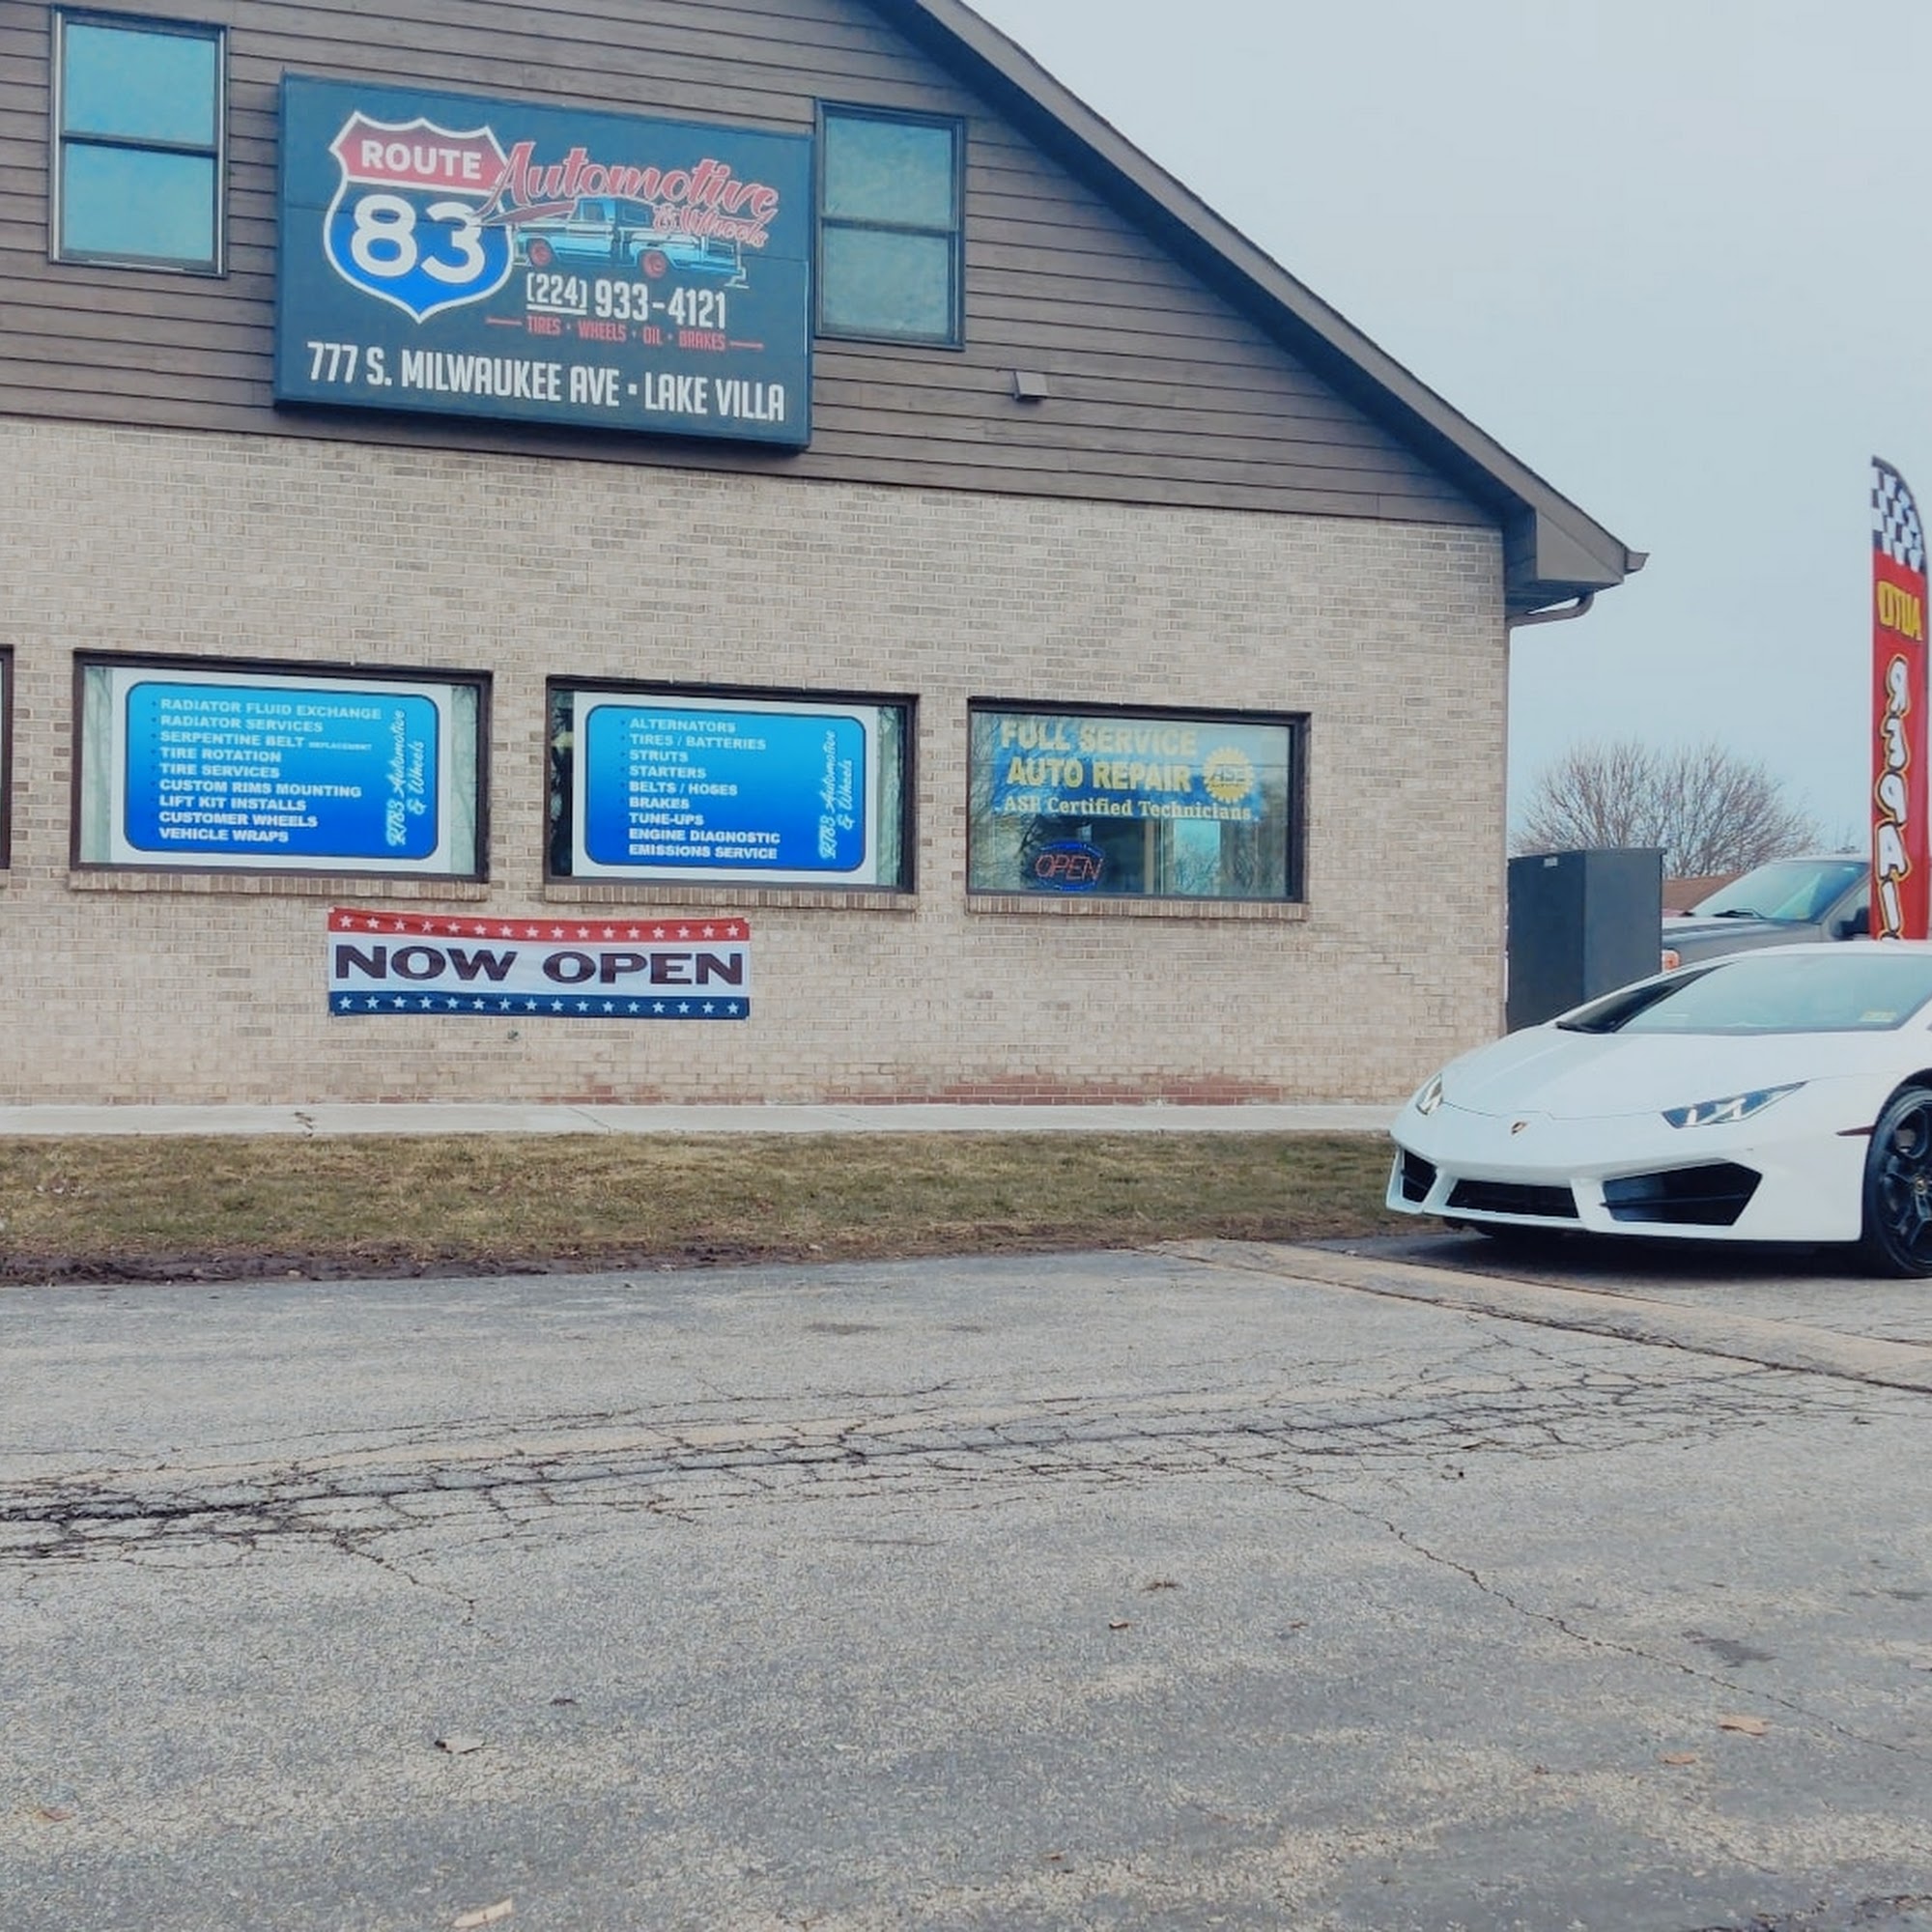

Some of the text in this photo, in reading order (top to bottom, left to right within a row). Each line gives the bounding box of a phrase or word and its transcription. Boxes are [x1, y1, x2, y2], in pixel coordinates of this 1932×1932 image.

[360, 140, 482, 181] ROUTE
[475, 140, 780, 225] Automotive
[351, 193, 485, 283] 83
[526, 271, 725, 329] (224) 933-4121
[526, 315, 725, 352] TIRES WHEELS OIL BRAKES
[307, 341, 784, 421] 777 S. MILWAUKEE AVE LAKE VILLA
[160, 698, 382, 720] RADIATOR FLUID EXCHANGE
[160, 715, 324, 733] RADIATOR SERVICES
[630, 718, 736, 733] ALTERNATORS
[160, 730, 262, 746] SERPENTINE
[266, 734, 305, 748] BELT
[630, 733, 673, 746] TIRES
[686, 735, 766, 750] BATTERIES
[1001, 720, 1198, 756] FULL SERVICE
[159, 747, 282, 763] TIRE ROTATION
[630, 750, 689, 763] STRUTS
[159, 763, 280, 779] TIRE SERVICES
[629, 765, 707, 780] STARTERS
[1007, 756, 1193, 792] AUTO REPAIR
[159, 779, 362, 798] CUSTOM RIMS MOUNTING
[629, 781, 676, 794] BELTS
[159, 795, 306, 811] LIFT KIT INSTALLS
[629, 797, 690, 810] BRAKES
[1048, 797, 1133, 816] Certified
[159, 811, 318, 828] CUSTOMER WHEELS
[629, 812, 704, 826] TUNE-UPS
[159, 827, 289, 842] VEHICLE WRAPS
[629, 828, 781, 844] ENGINE DIAGNOSTIC
[629, 844, 778, 860] EMISSIONS SERVICE
[1036, 854, 1104, 881] OPEN
[335, 944, 743, 985] NOW OPEN
